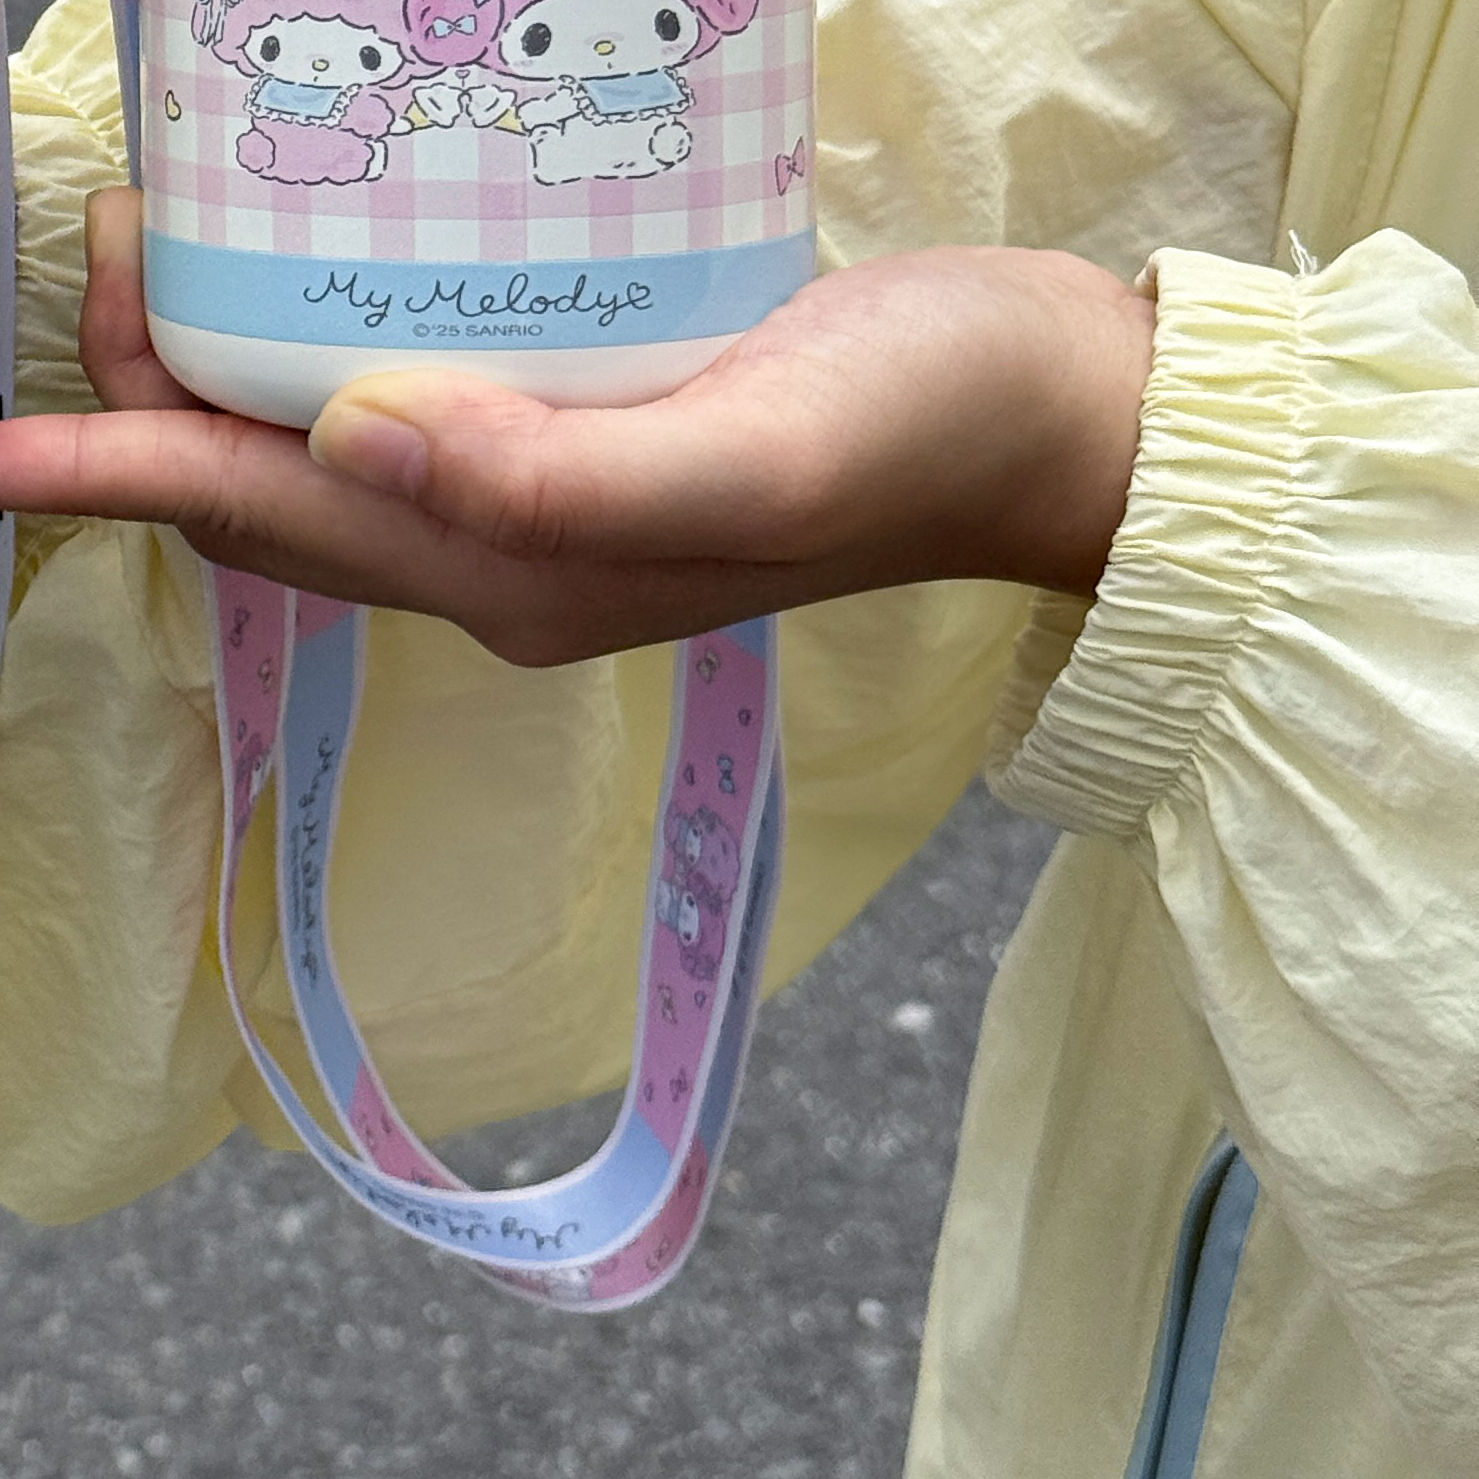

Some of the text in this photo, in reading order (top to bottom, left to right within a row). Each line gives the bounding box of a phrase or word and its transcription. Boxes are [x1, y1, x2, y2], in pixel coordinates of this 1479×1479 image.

[303, 271, 622, 328] My Melody
[464, 323, 544, 338] SANRIO
